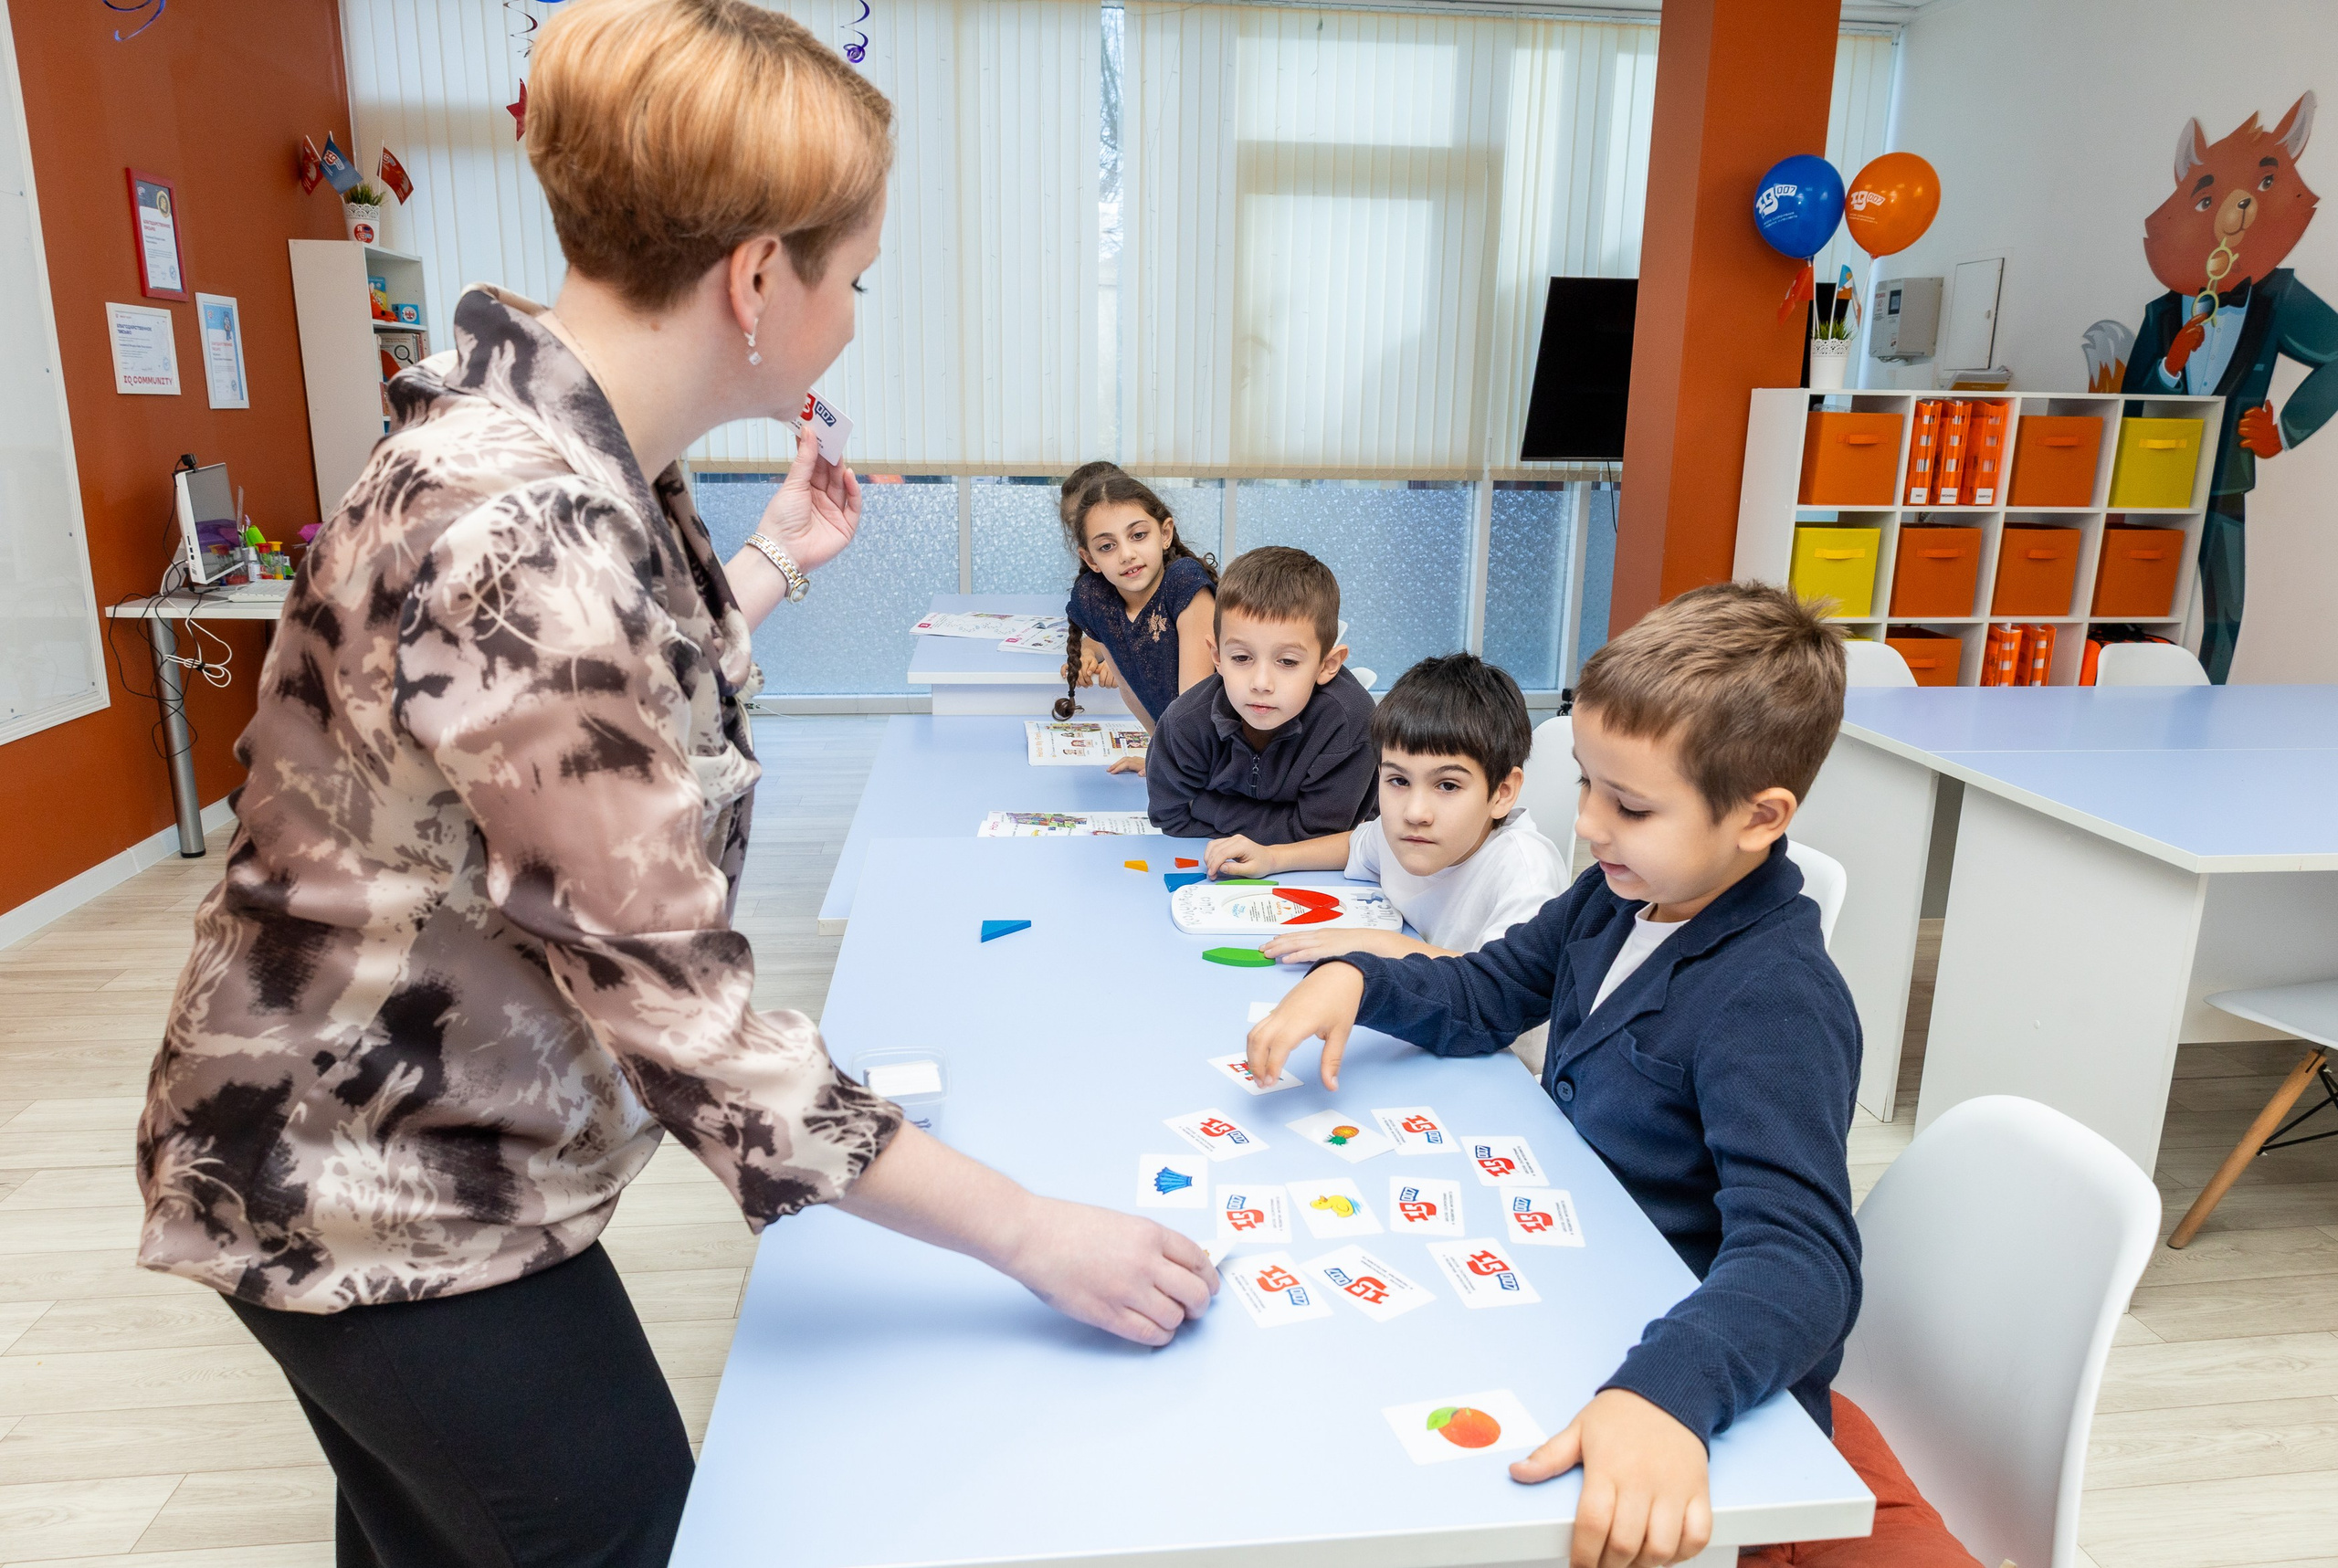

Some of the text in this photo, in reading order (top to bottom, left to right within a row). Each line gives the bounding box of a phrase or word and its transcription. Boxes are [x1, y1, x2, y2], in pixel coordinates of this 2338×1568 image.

[1775, 184, 1797, 197] 007
[1868, 193, 1885, 206] 007
[133, 375, 173, 385] COMMUNITY
[815, 401, 837, 427] 007
